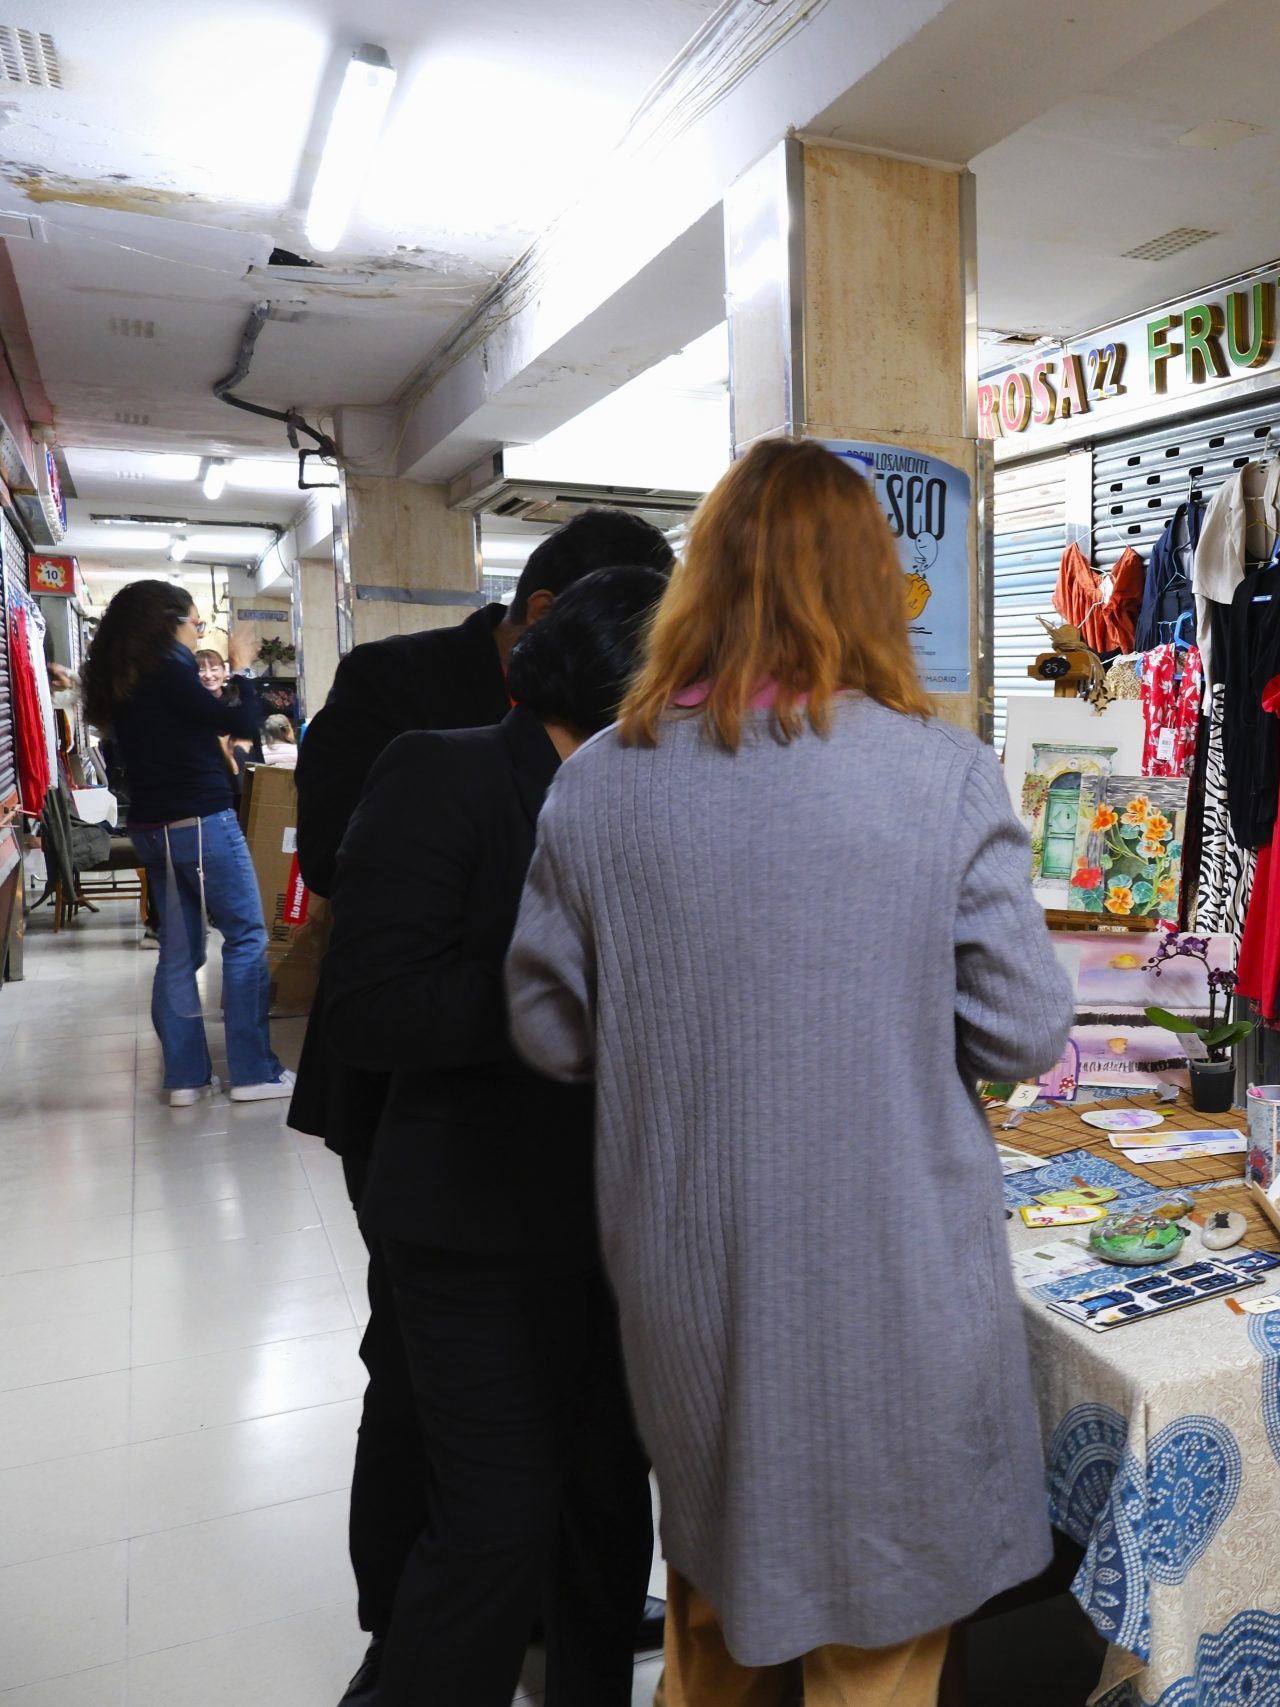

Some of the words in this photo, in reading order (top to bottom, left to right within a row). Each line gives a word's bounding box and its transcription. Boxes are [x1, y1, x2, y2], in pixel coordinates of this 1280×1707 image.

[978, 354, 1092, 441] ROSA
[1087, 342, 1127, 401] 22
[875, 473, 947, 541] SCO
[45, 569, 58, 580] 10
[925, 675, 957, 683] MADRID
